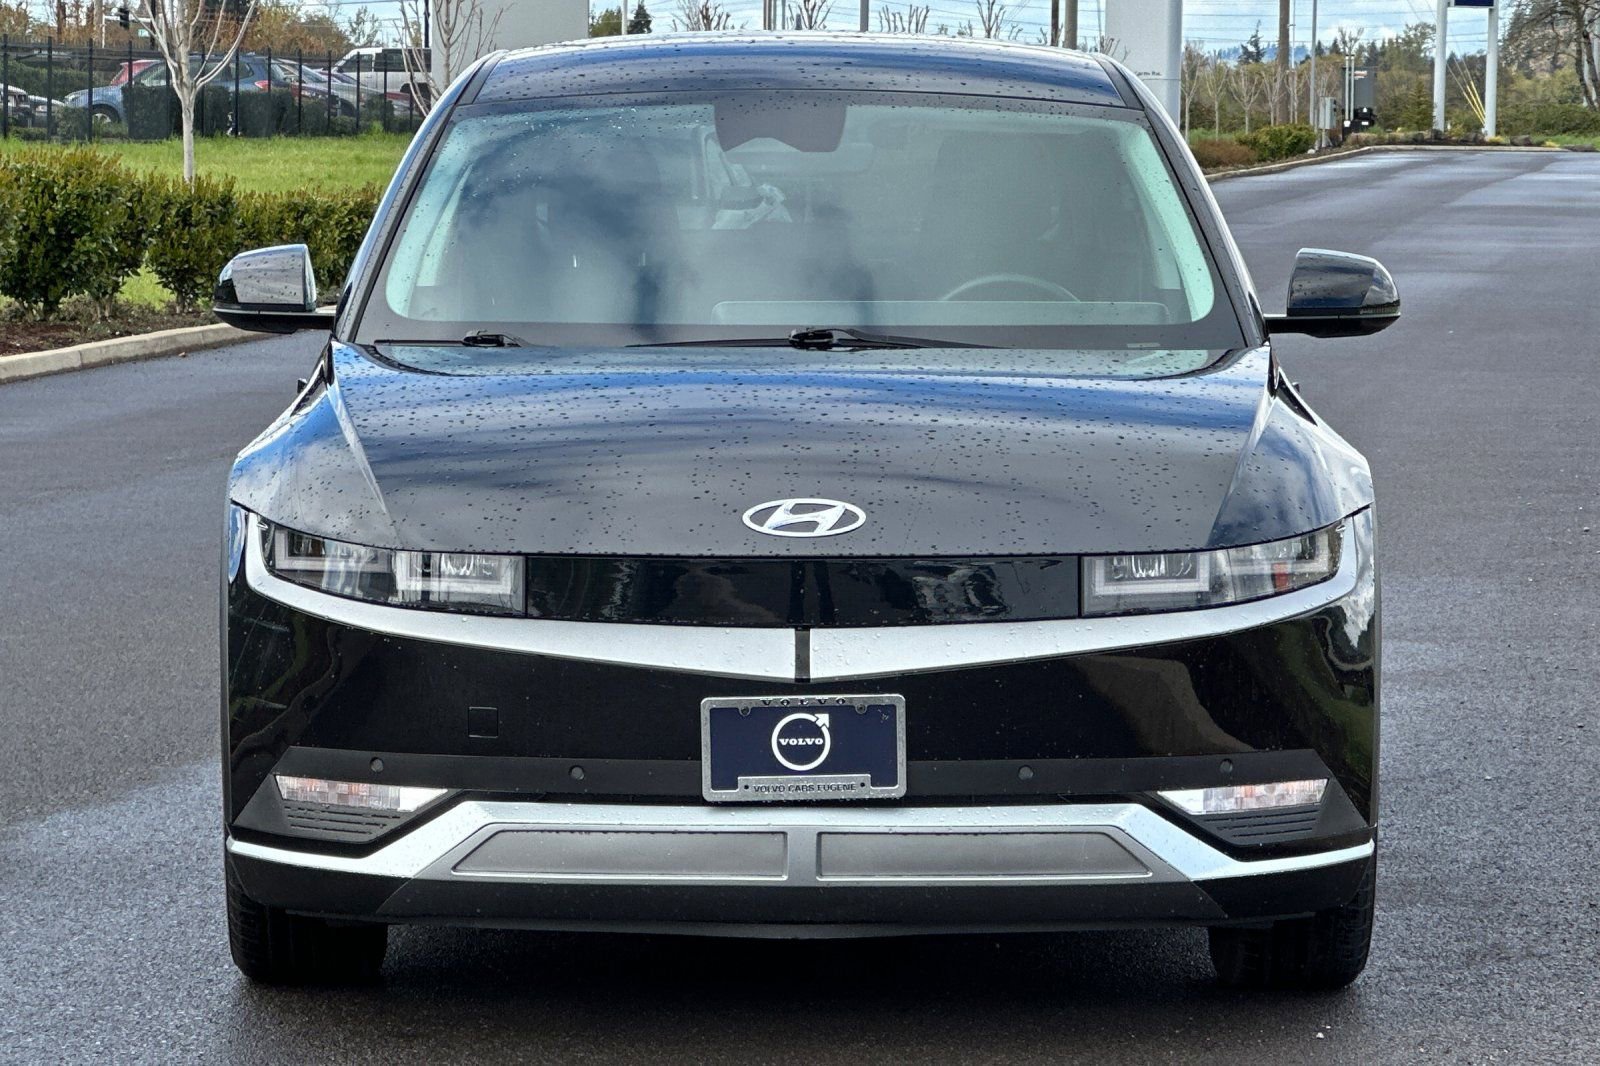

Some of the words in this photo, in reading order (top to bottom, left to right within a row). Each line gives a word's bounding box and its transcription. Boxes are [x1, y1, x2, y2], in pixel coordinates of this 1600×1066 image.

[779, 738, 823, 746] VOLVO
[753, 784, 786, 793] VOLVO
[788, 783, 815, 792] CARS
[817, 782, 857, 792] EUGENE
